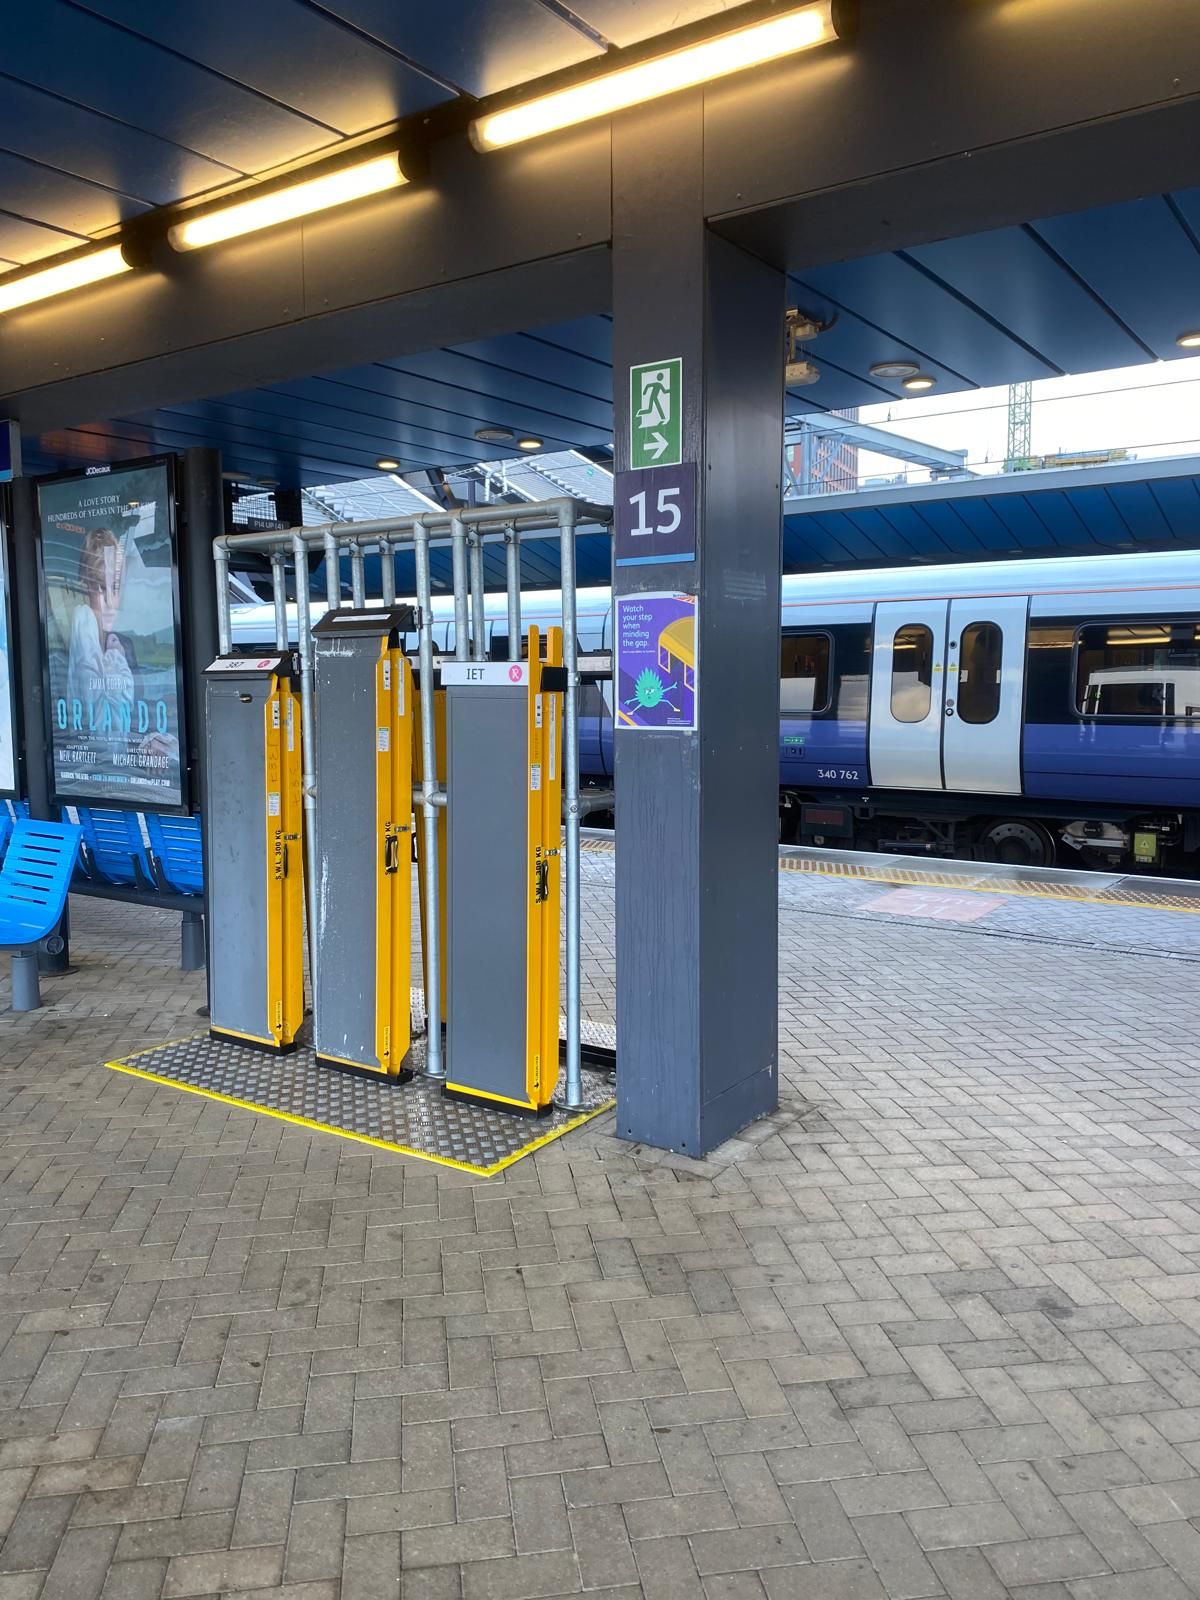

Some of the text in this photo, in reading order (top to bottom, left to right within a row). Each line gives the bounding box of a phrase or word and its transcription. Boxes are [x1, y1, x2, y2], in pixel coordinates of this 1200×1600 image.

[86, 466, 111, 475] JCDecaux
[83, 498, 99, 507] LOVE
[100, 495, 120, 505] STORY
[47, 511, 78, 523] HUNDREDS
[78, 510, 86, 519] OF
[88, 507, 107, 517] YEARS
[108, 506, 115, 515] IN
[116, 504, 130, 514] THE
[629, 487, 682, 537] 15
[265, 521, 274, 529] UP
[622, 605, 644, 613] Watch
[638, 614, 653, 623] step
[622, 622, 641, 630] when
[622, 631, 650, 639] minding
[466, 668, 486, 680] IET
[57, 698, 168, 734] ORLANDO
[60, 750, 97, 763] NEIL BARTLETT
[112, 752, 169, 769] MICHAEL GRANDAGE
[817, 769, 859, 780] 340 762
[385, 821, 391, 832] KG
[275, 830, 282, 840] KG
[535, 846, 542, 858] KG
